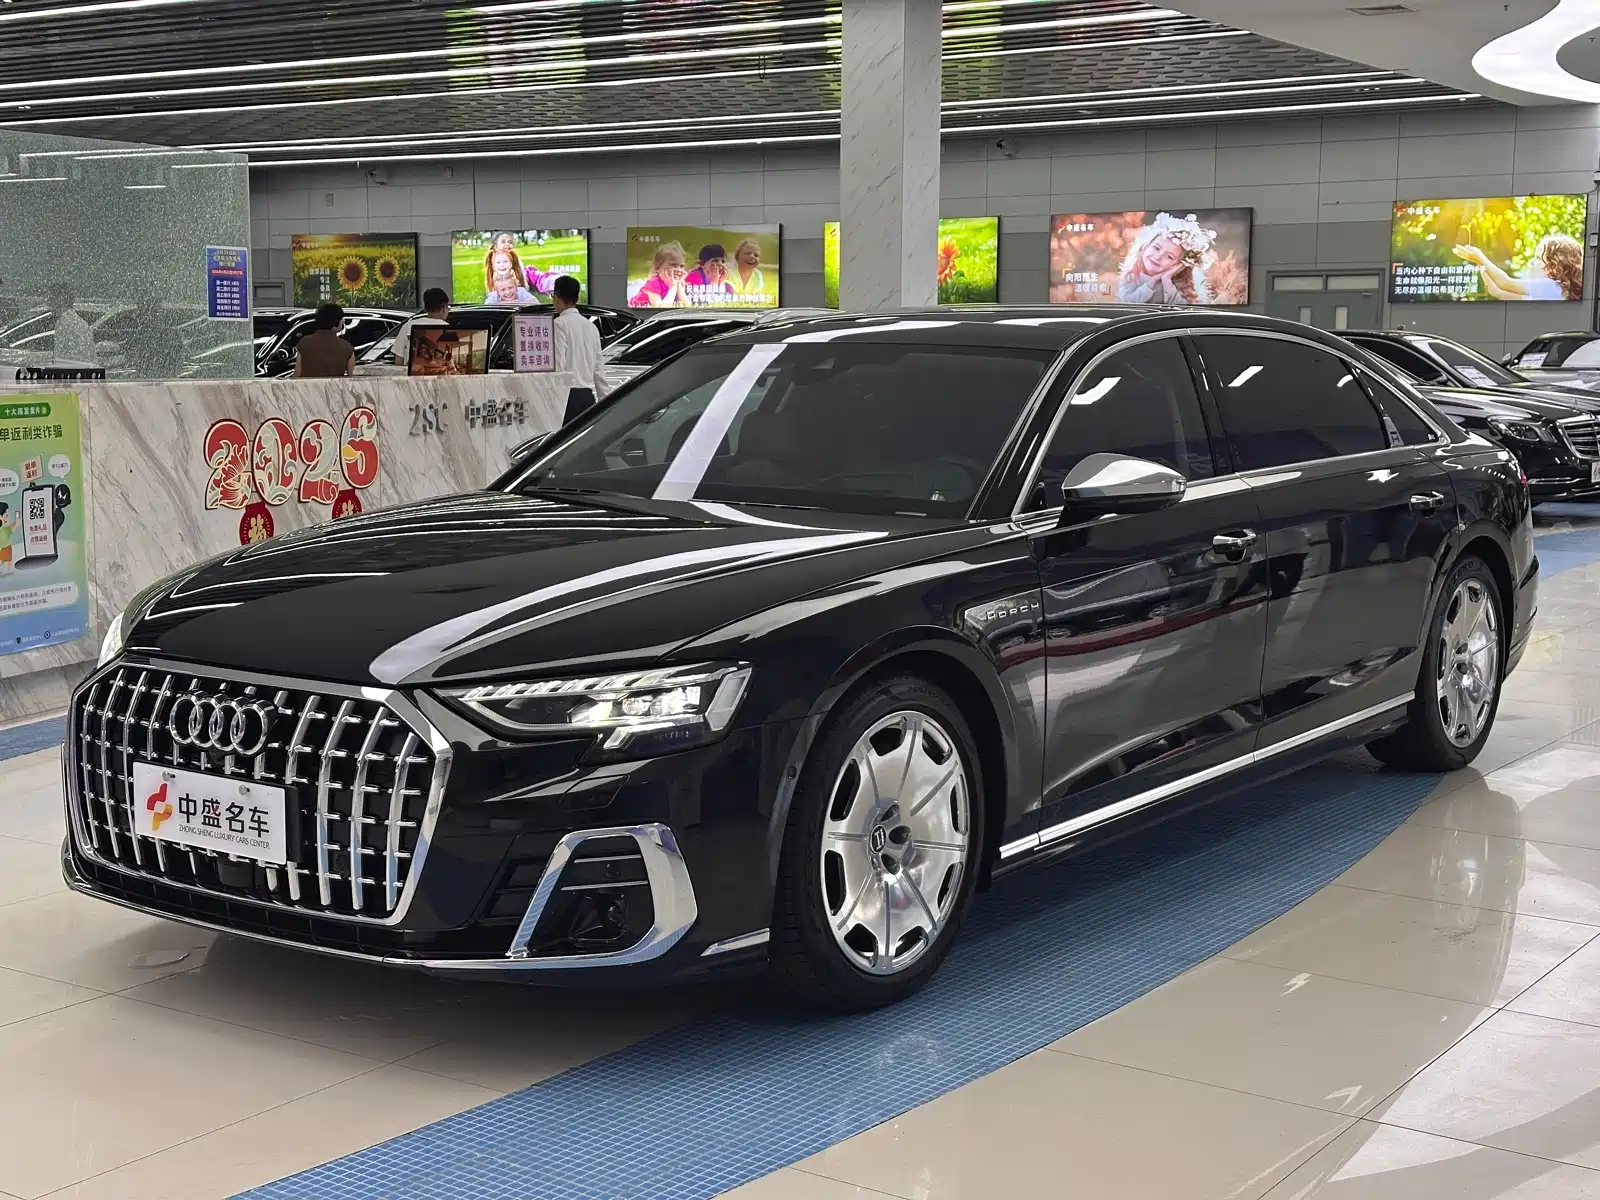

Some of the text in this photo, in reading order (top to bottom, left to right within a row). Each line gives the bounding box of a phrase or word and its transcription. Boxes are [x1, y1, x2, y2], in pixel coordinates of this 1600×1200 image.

[520, 326, 549, 338] 专业评估
[520, 340, 550, 352] 置换收购
[520, 354, 550, 366] 卖车咨询
[465, 397, 529, 429] 中盛名车
[0, 424, 63, 441] 单返利类诈骗
[987, 602, 1039, 620] HORCH
[178, 793, 270, 838] 中盛名车
[179, 824, 270, 849] ZHONG SHENG LUXURY CARS CENTER
